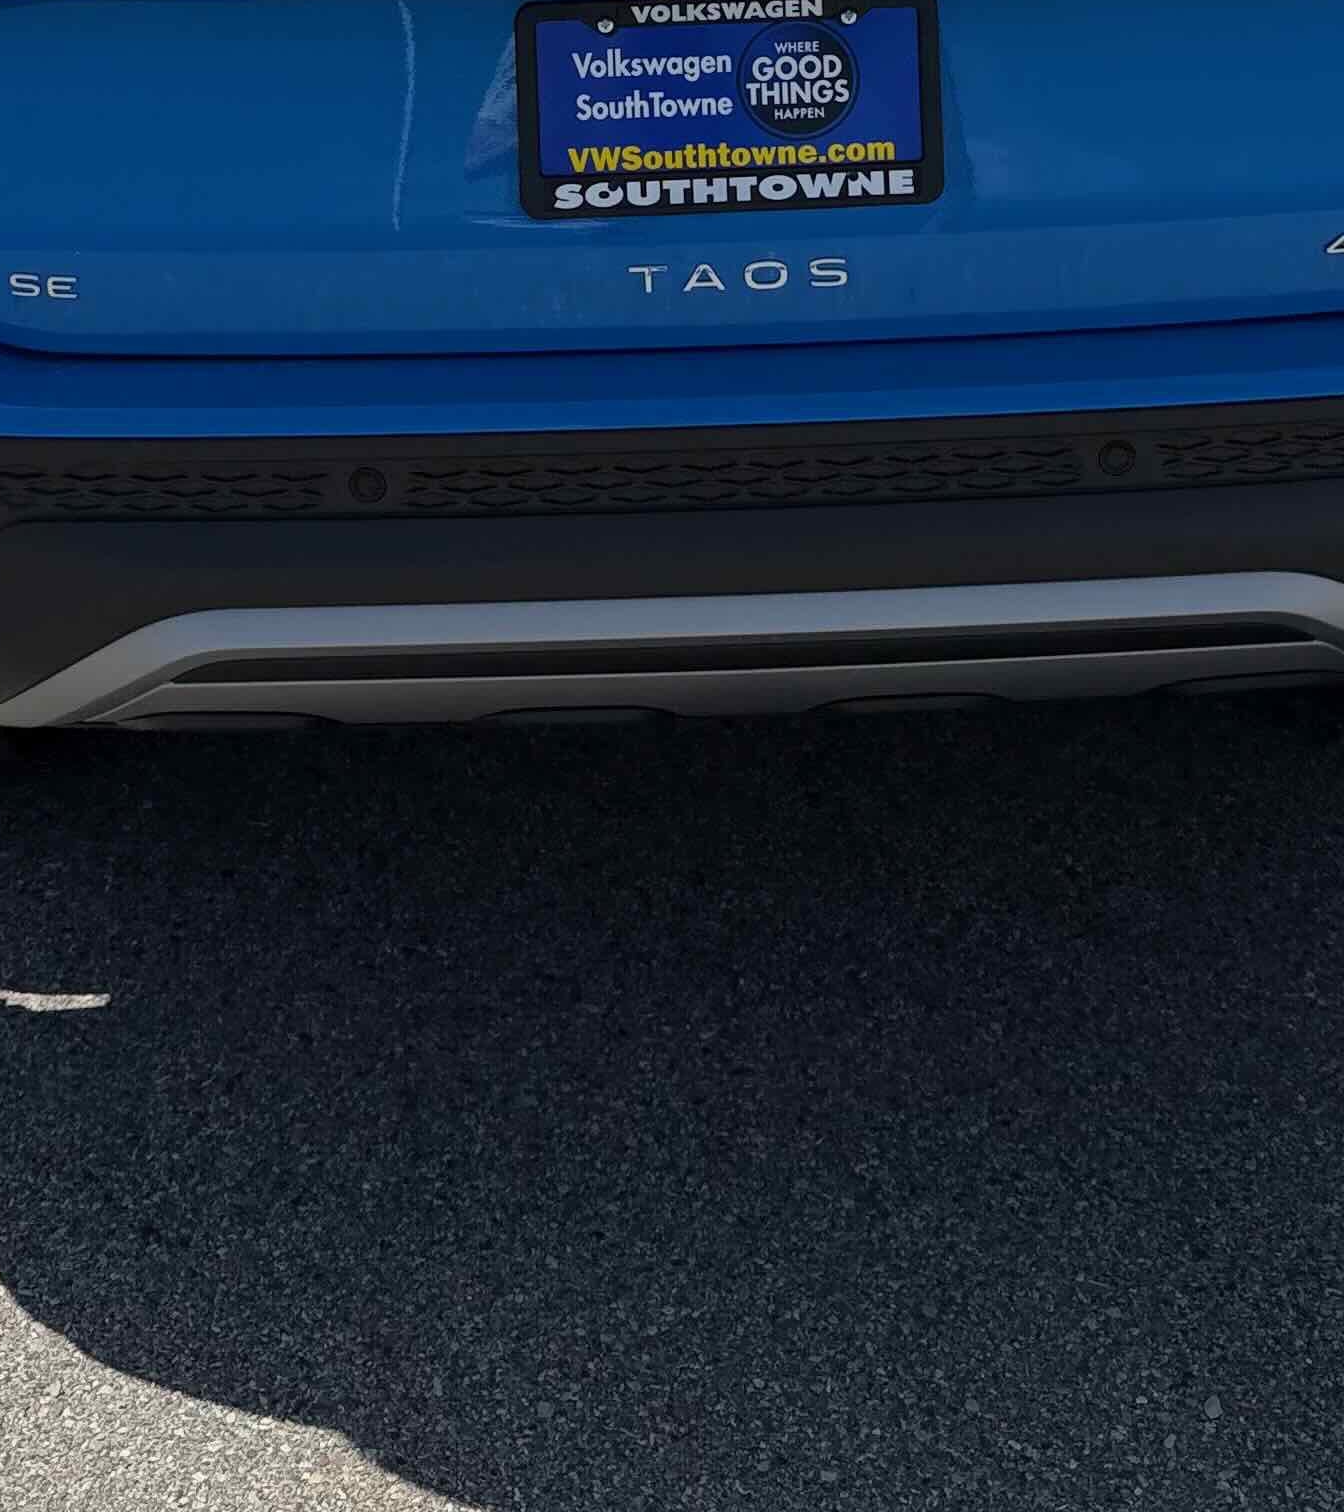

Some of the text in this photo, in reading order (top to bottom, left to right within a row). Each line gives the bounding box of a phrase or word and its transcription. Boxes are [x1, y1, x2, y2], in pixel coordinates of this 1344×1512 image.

[774, 40, 820, 54] WHERE
[571, 48, 732, 82] Volkswagen
[752, 54, 842, 81] GOOD
[576, 89, 734, 120] SouthTowne
[745, 78, 850, 106] THINGS
[774, 106, 825, 120] HAPPEN
[567, 140, 896, 173] VWSouthtowne.com
[553, 169, 915, 209] SOUTHTOWNE
[9, 273, 78, 299] SE
[627, 258, 848, 293] TAOS
